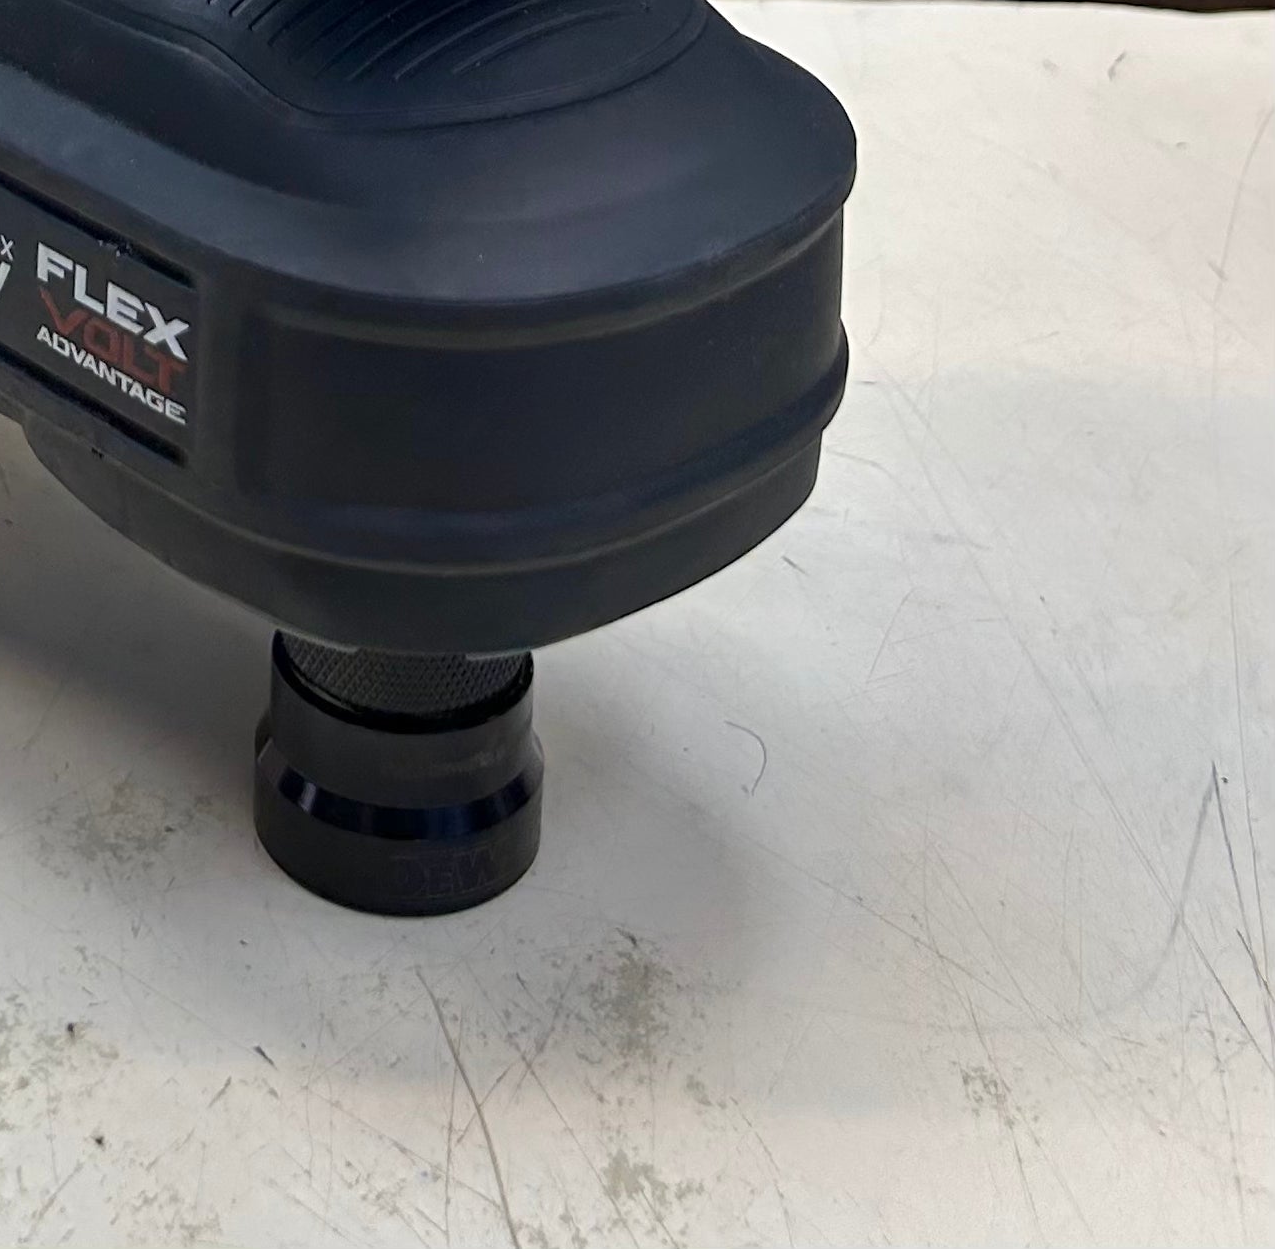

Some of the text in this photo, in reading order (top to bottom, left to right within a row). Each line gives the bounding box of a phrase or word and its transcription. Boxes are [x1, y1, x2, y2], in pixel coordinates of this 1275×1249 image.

[36, 241, 190, 362] FLEX
[38, 286, 189, 396] VOLT
[35, 325, 187, 426] ADVANTAGE
